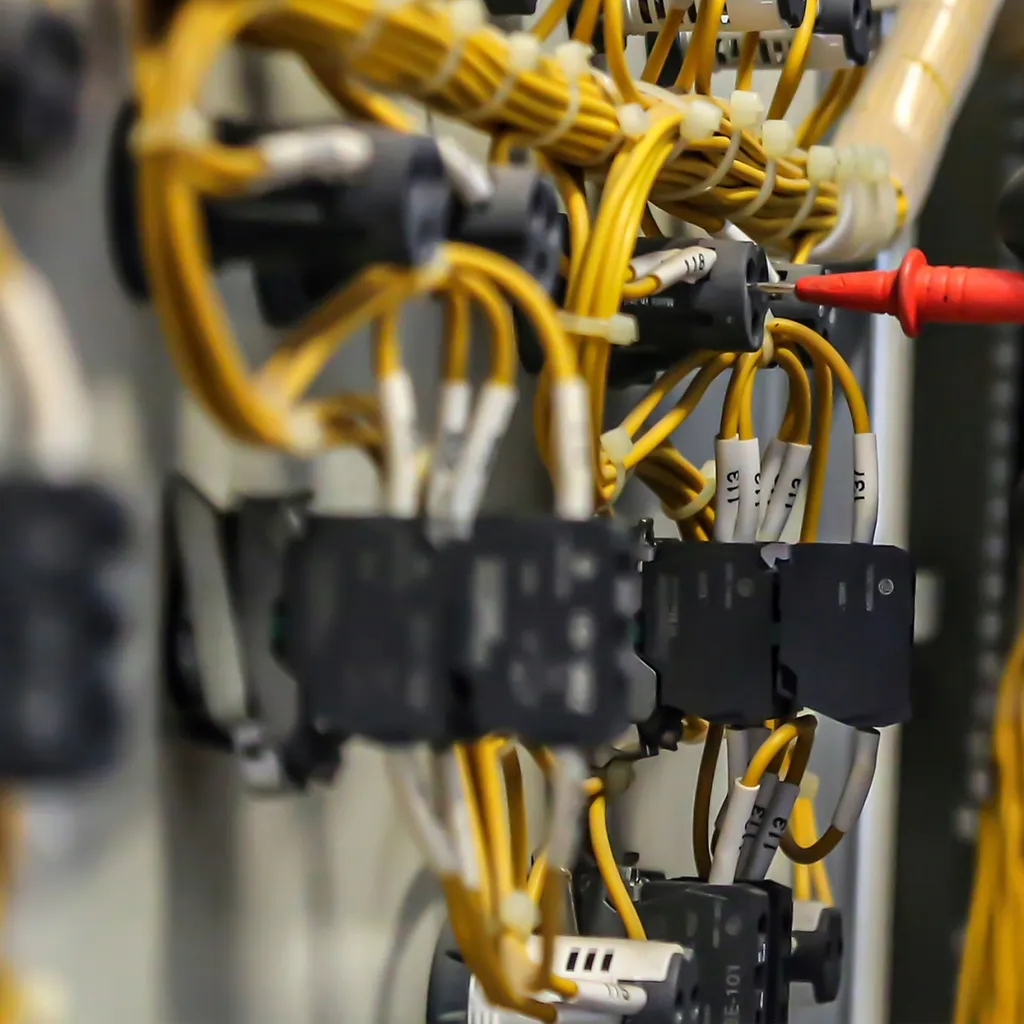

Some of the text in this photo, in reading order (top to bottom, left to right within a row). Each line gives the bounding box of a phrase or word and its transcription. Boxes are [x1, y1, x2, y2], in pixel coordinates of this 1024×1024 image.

[684, 253, 705, 273] 118
[727, 470, 739, 504] 113
[854, 469, 865, 502] 137
[763, 817, 787, 850] 113
